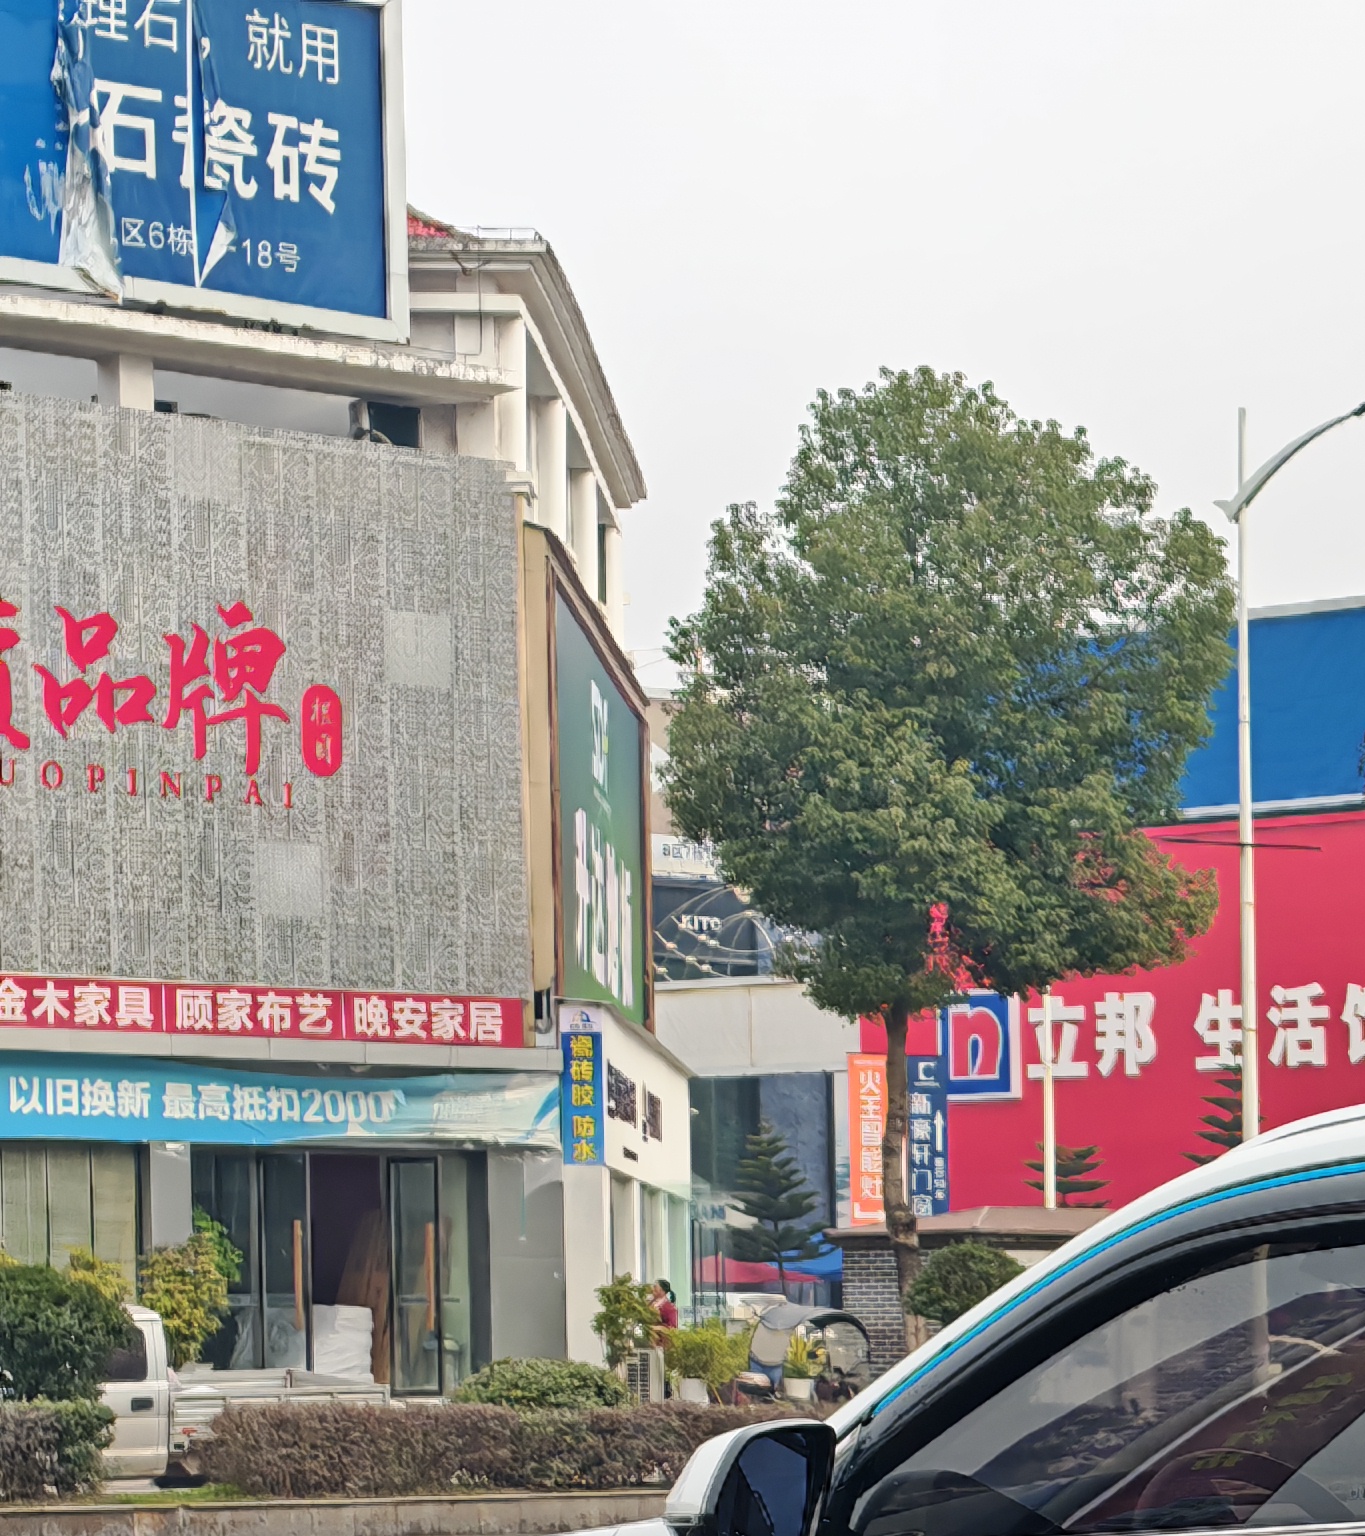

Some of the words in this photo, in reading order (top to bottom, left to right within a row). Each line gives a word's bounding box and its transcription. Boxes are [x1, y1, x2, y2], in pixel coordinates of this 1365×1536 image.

[245, 8, 341, 85] 就用
[175, 987, 334, 1034] 顾家布艺
[353, 995, 503, 1044] 晚安家居
[1027, 989, 1157, 1080] 立邦
[9, 1075, 151, 1119] 以旧换新
